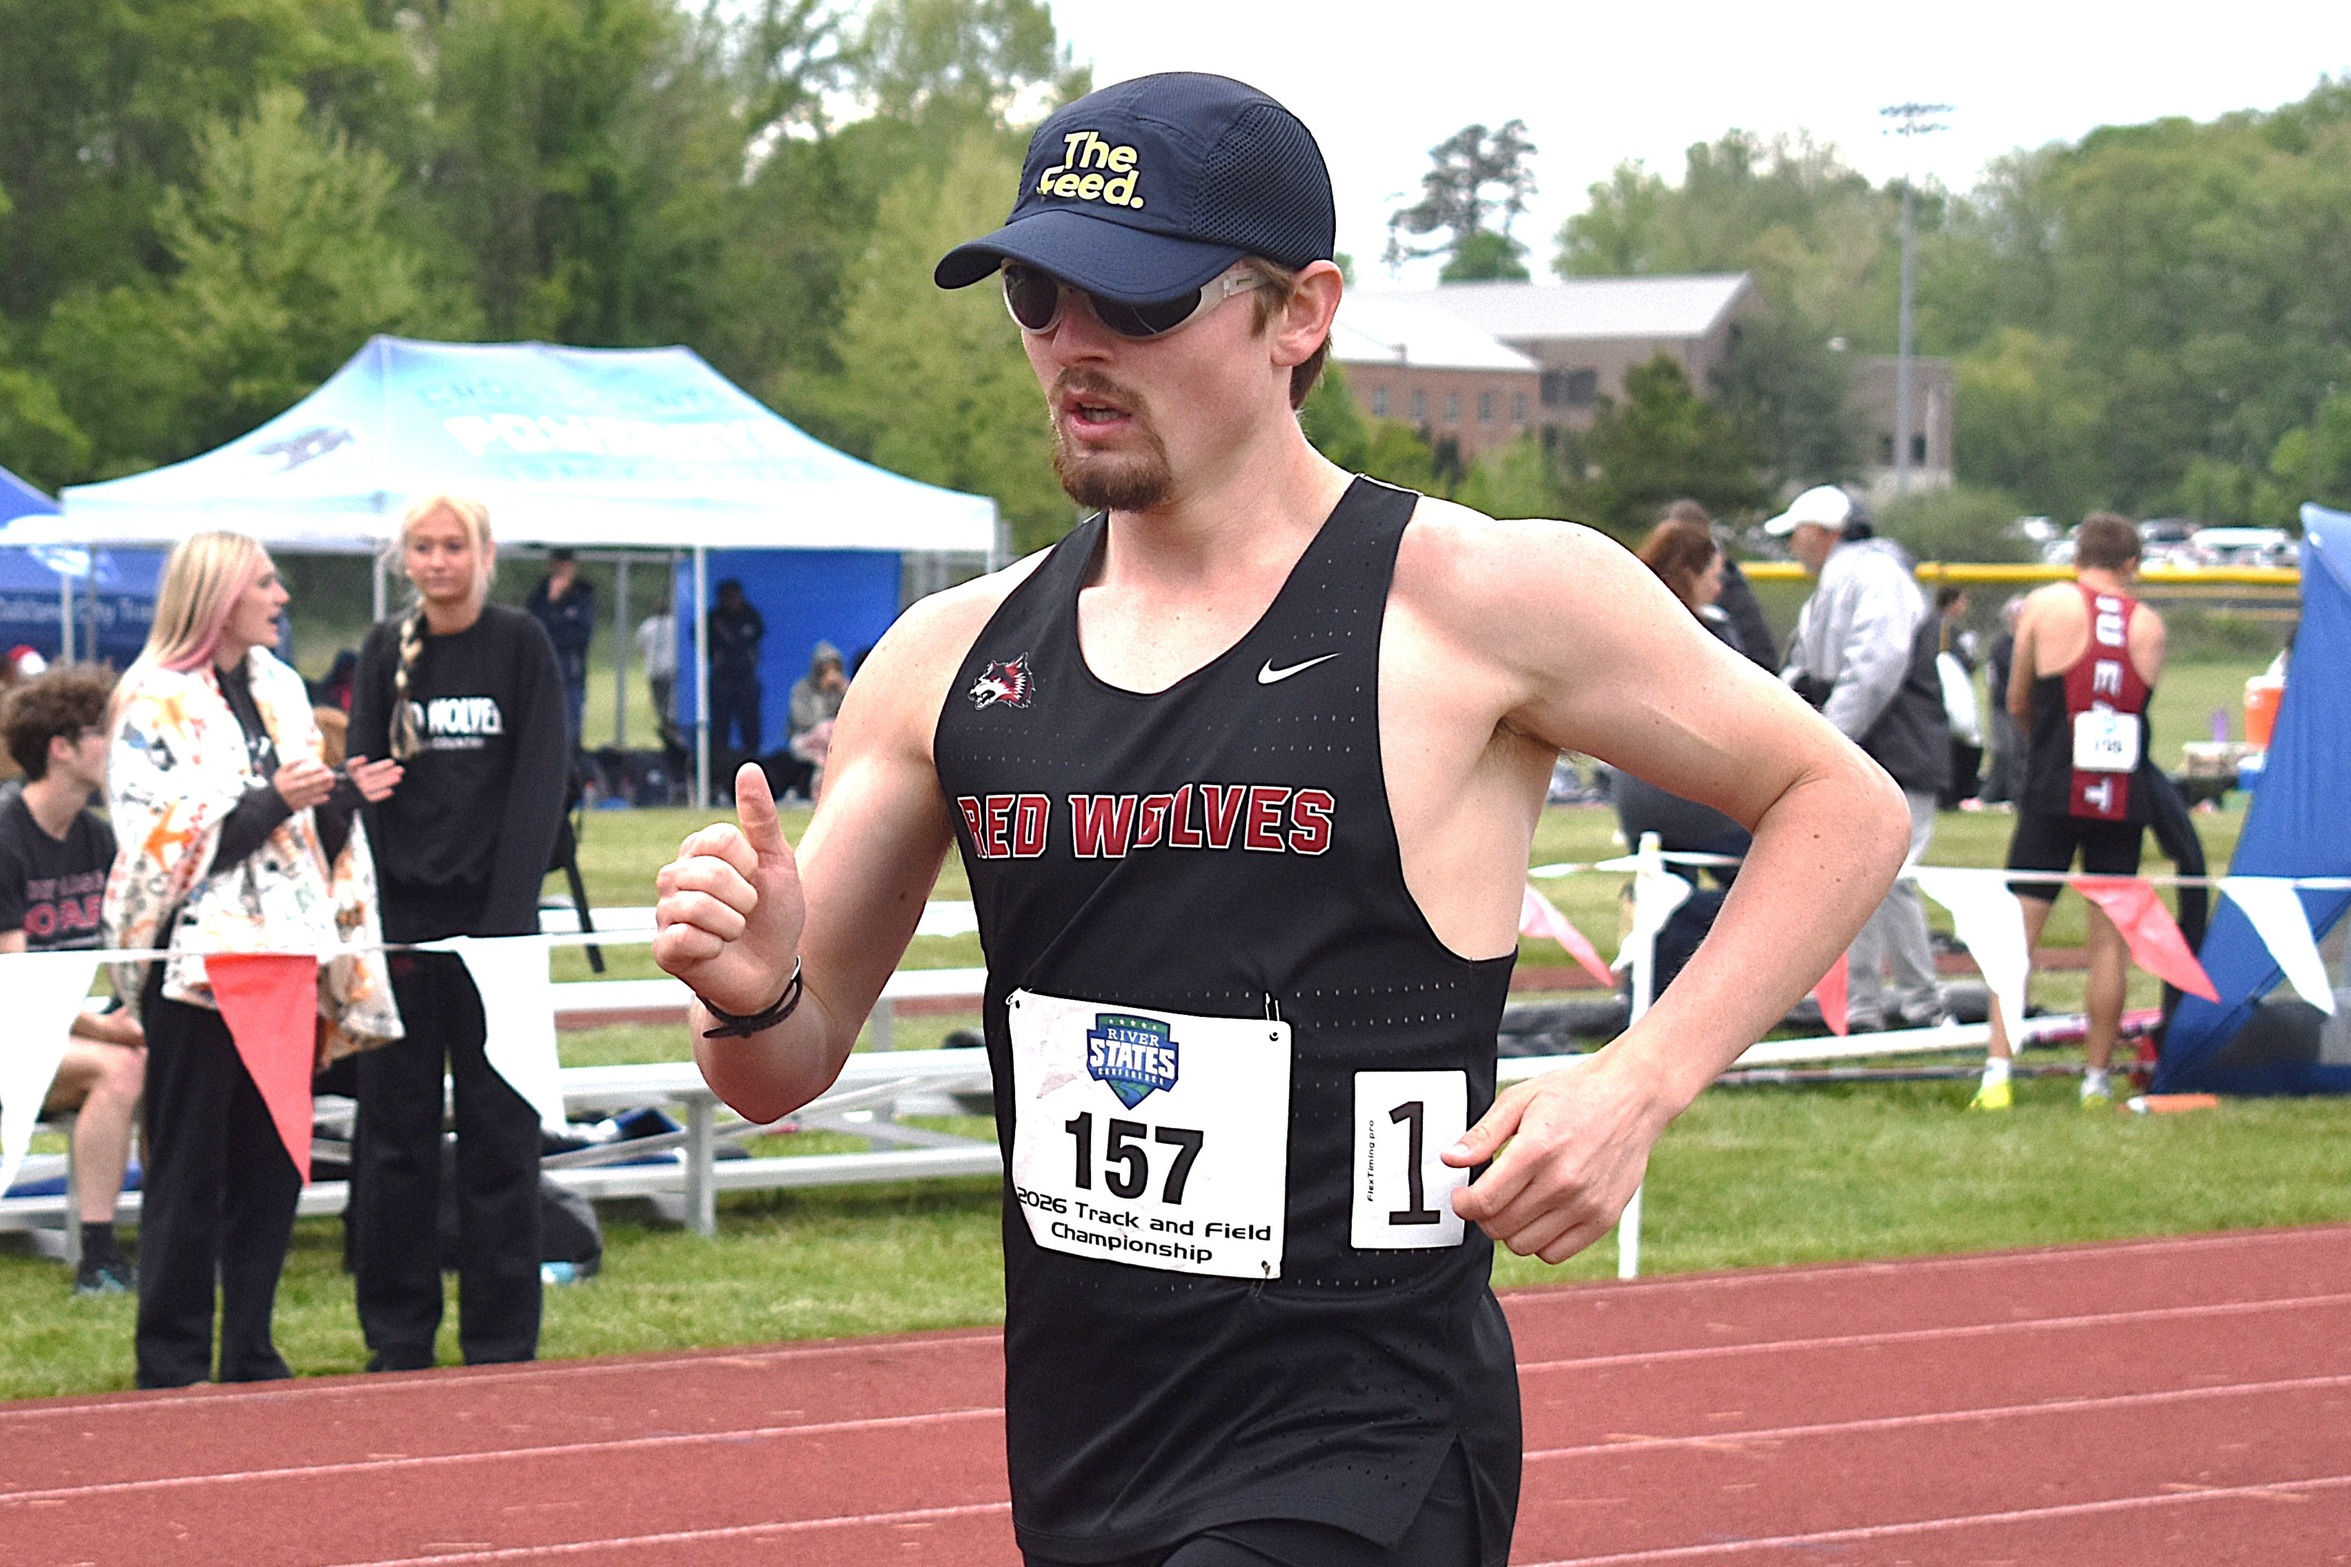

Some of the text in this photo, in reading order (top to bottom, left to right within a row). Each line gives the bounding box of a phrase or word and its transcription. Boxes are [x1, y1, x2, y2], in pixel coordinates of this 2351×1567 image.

[1064, 131, 1138, 173] The
[957, 783, 1336, 859] RED WOLVES
[1089, 1037, 1176, 1080] STATES
[1107, 1028, 1160, 1047] RIVER
[1065, 1111, 1204, 1205] 157
[1366, 1142, 1376, 1202] FlexTiming
[1388, 1100, 1441, 1226] 1
[1017, 1186, 1272, 1241] 2026 Track and Field
[1051, 1221, 1213, 1264] Championship
